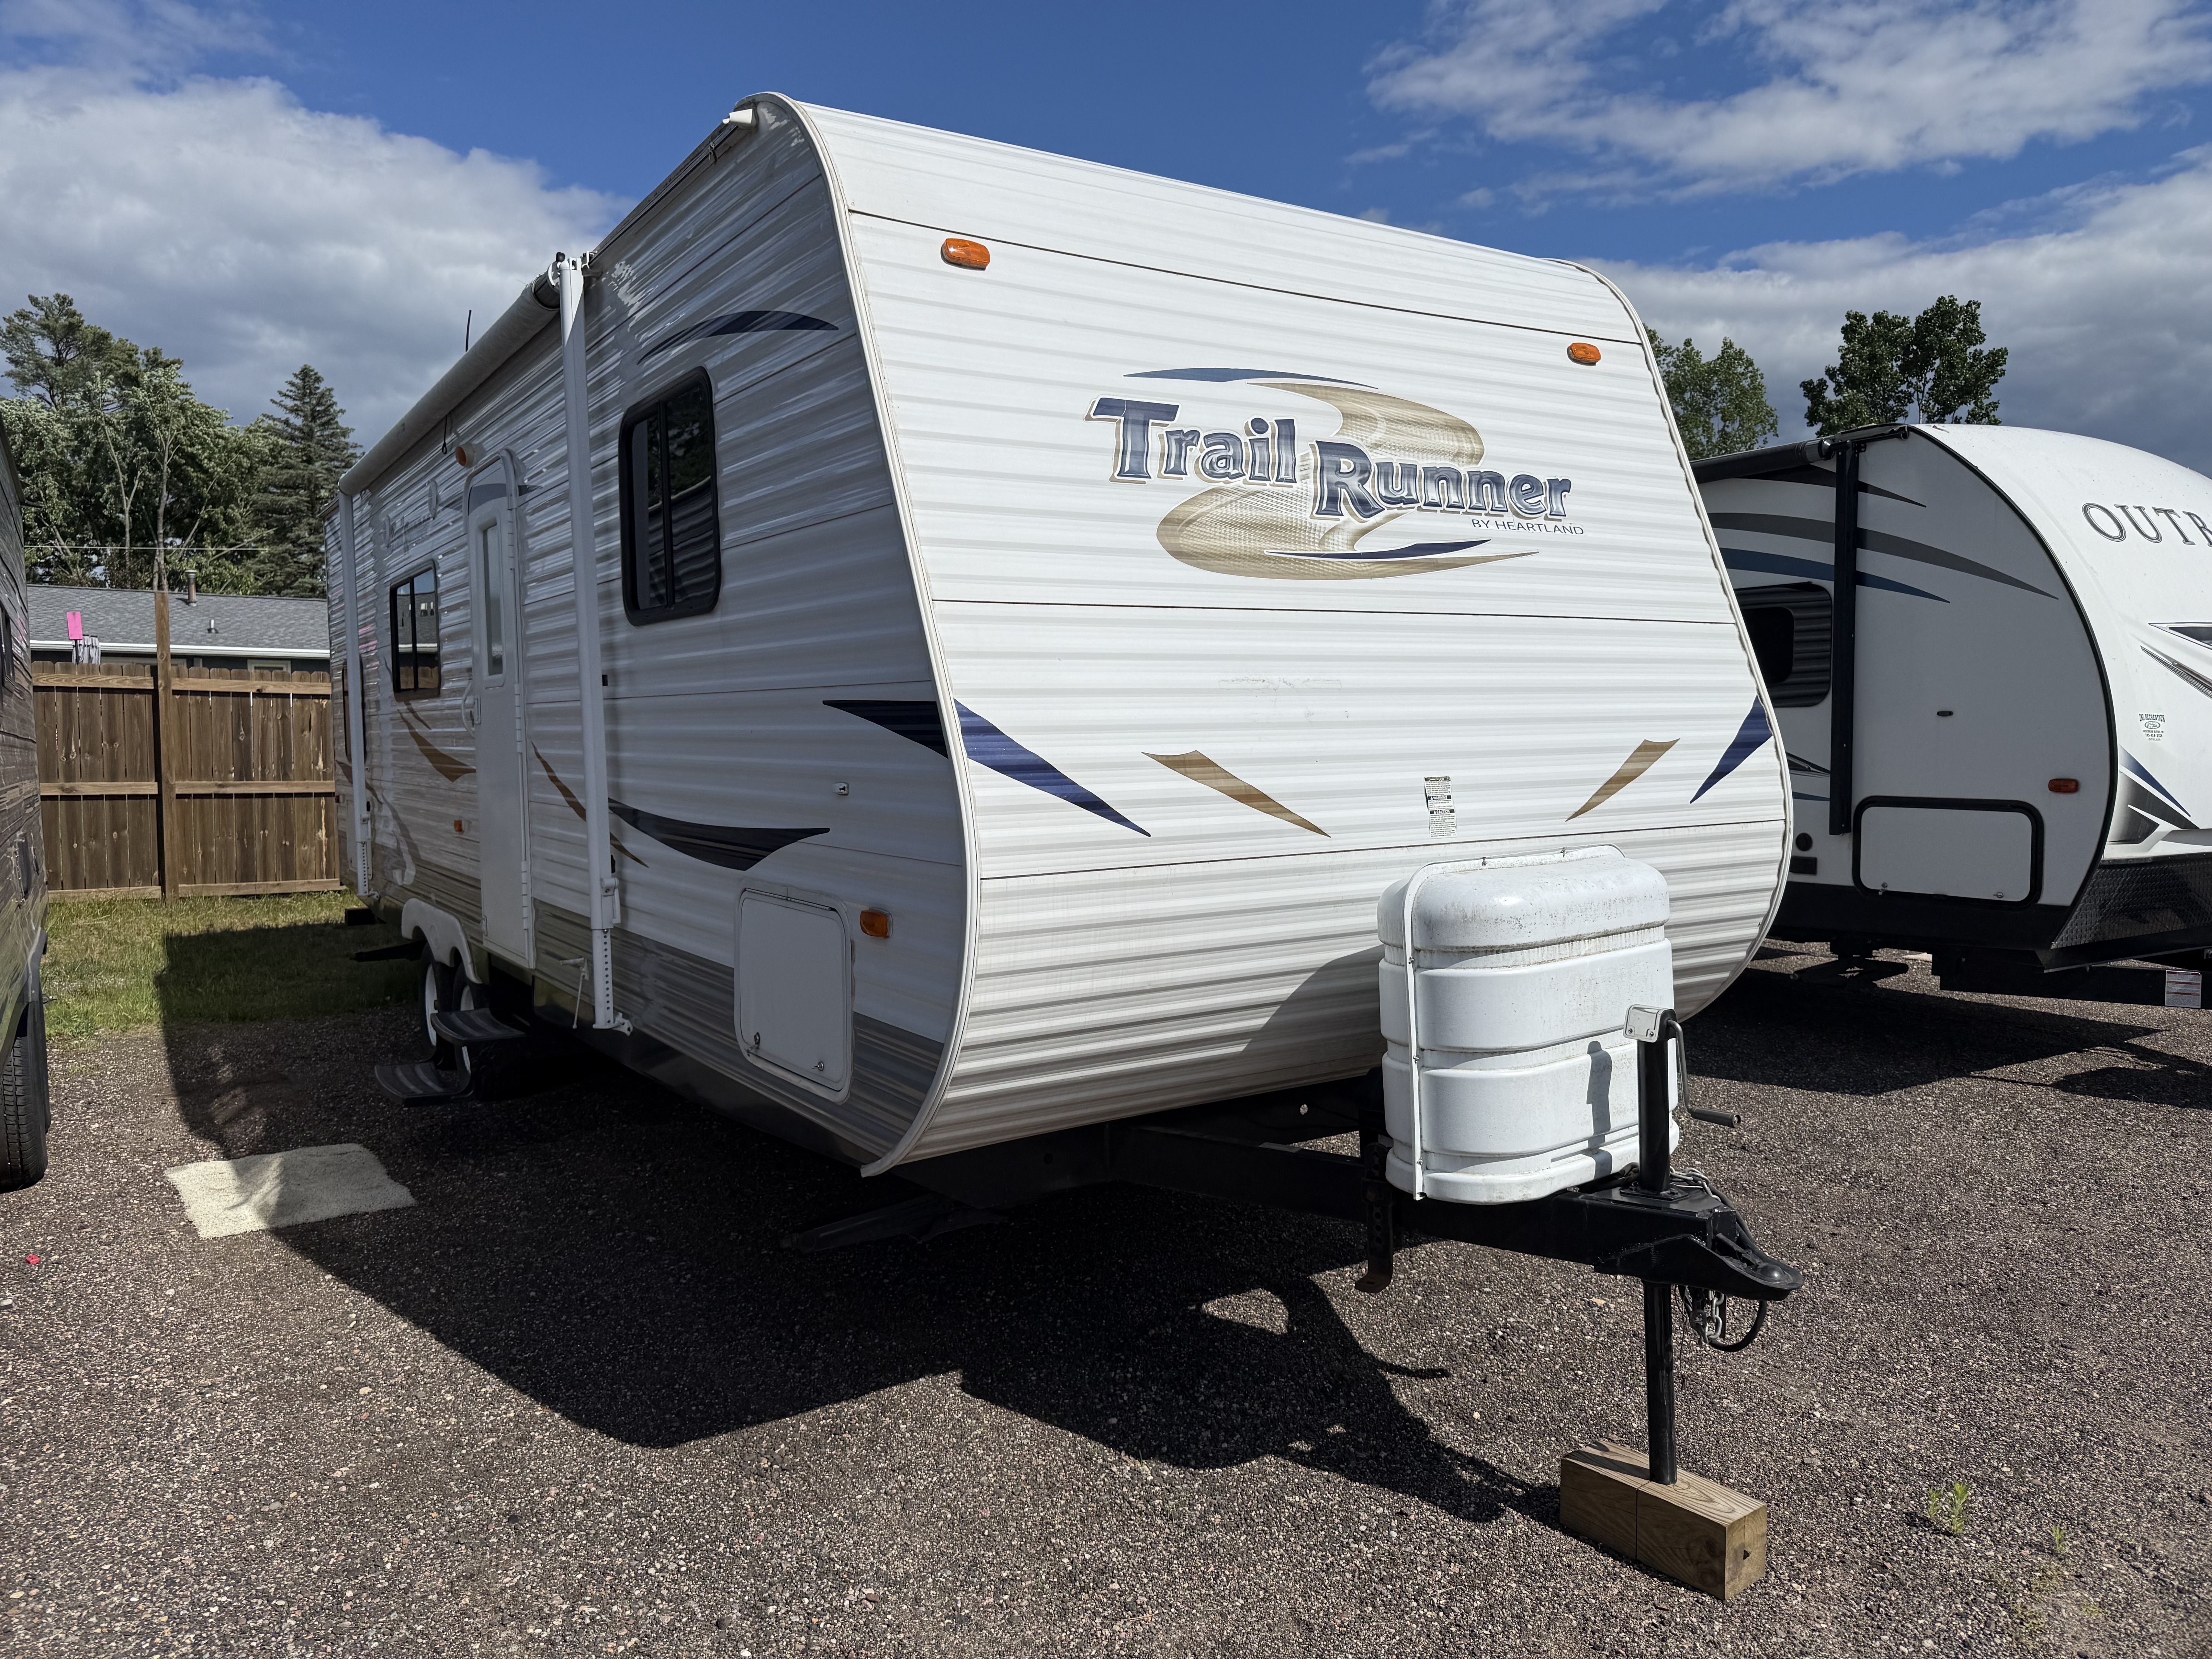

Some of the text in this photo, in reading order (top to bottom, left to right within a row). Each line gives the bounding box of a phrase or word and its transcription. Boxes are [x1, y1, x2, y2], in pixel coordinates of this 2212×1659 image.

[1085, 397, 1571, 521] Trail Runner
[1471, 519, 1584, 535] BY HEARTLAND
